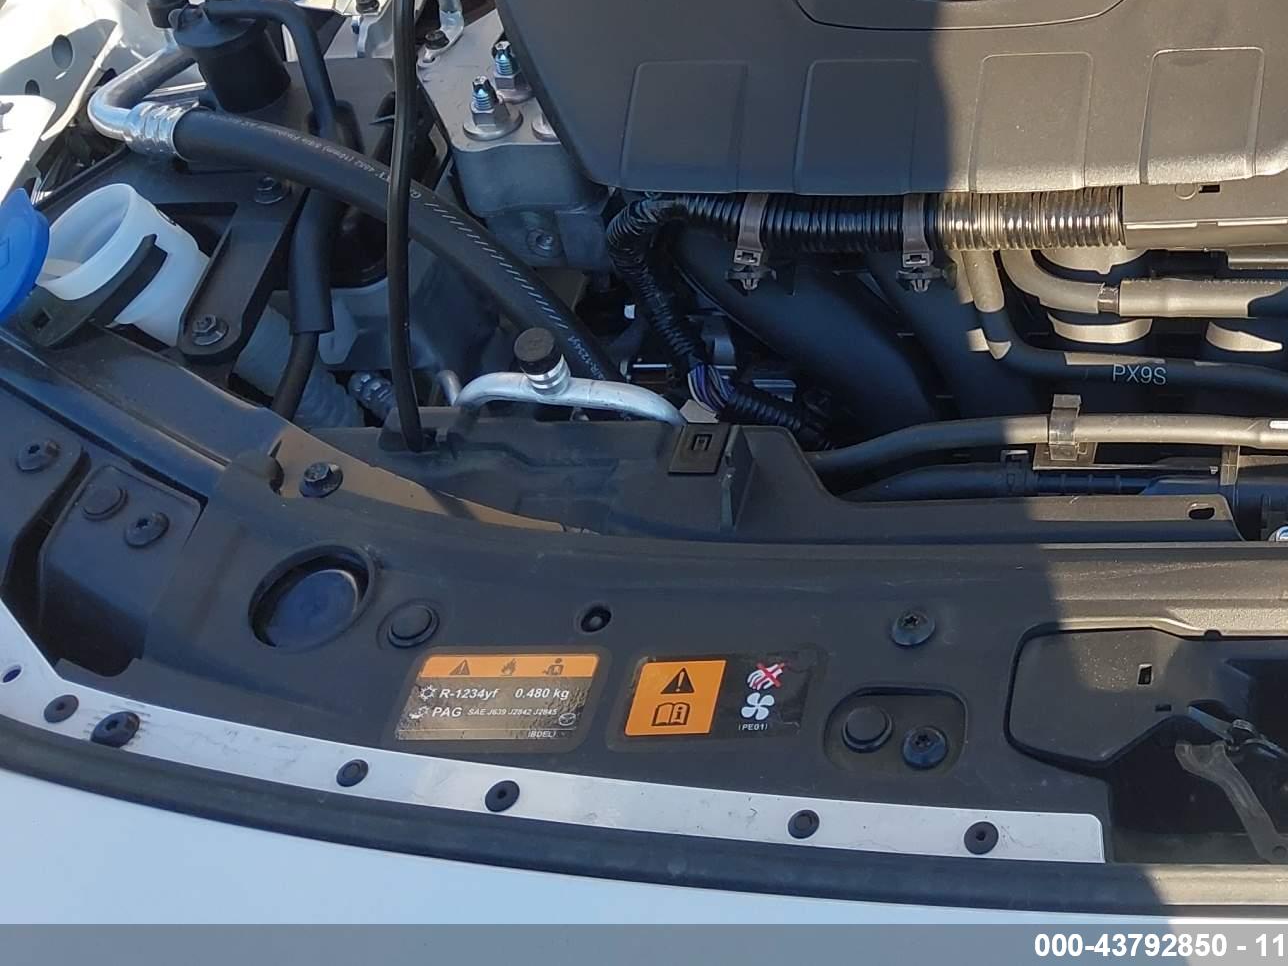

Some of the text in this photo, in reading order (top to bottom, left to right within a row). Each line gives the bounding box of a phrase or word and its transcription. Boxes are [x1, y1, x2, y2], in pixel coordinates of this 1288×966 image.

[1112, 363, 1167, 385] PX9S
[439, 688, 569, 701] R-1234yf 0.480 kg
[432, 707, 462, 718] PAG
[467, 708, 486, 716] SAE
[738, 723, 768, 731] (PE01)
